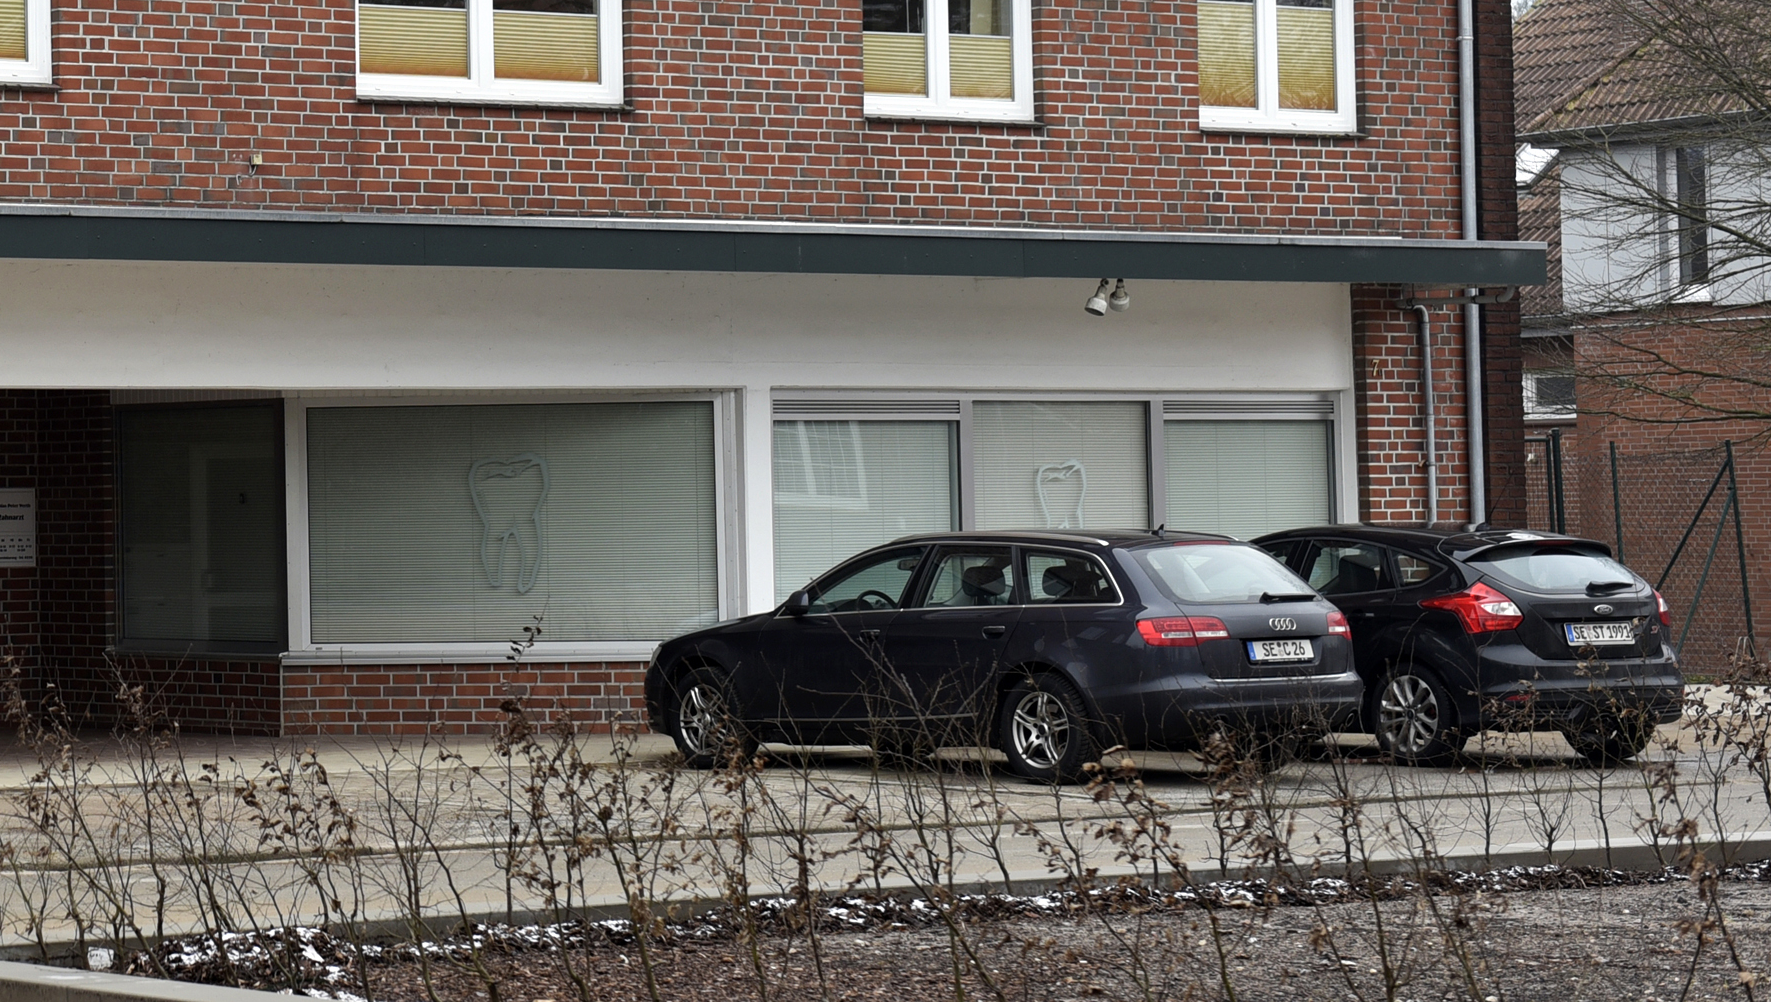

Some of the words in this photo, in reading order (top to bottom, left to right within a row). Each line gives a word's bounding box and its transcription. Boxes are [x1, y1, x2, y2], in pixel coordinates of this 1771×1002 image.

[1573, 626, 1587, 639] SE
[1592, 626, 1605, 639] ST
[1606, 625, 1630, 638] 1991
[1262, 642, 1277, 657] SE
[1282, 642, 1291, 656] C
[1291, 641, 1305, 655] 26
